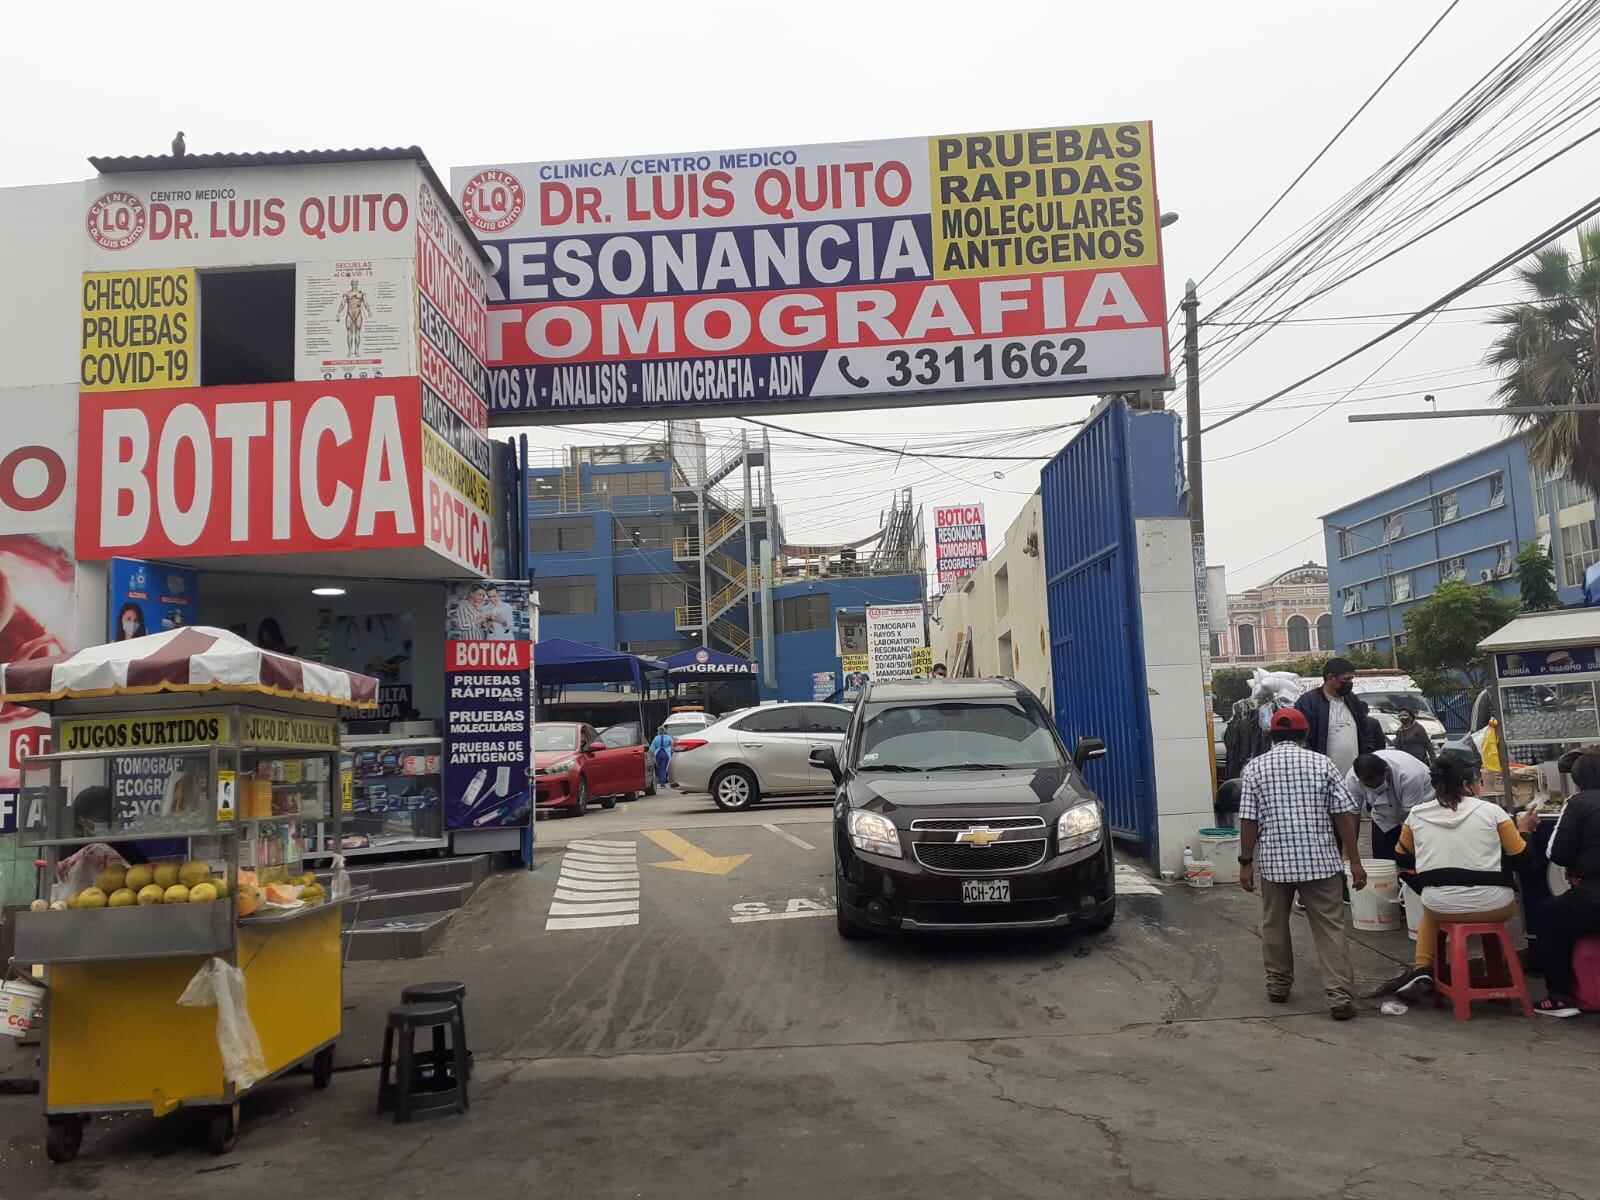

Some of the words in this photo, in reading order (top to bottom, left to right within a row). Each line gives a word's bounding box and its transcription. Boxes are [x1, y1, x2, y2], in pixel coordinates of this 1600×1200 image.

[719, 150, 798, 170] MEDICO
[938, 124, 1142, 172] PRUEBAS
[150, 190, 192, 203] CENTRO
[195, 188, 236, 201] MEDICO
[465, 170, 520, 196] CLINICA
[539, 181, 612, 227] DR.
[625, 170, 736, 222] LUIS
[754, 160, 912, 221] QUITO
[940, 162, 1143, 204] RAPIDAS
[91, 192, 144, 216] CLINICA
[478, 186, 507, 213] LQ
[102, 206, 130, 232] LQ
[149, 202, 200, 241] DR.
[209, 197, 286, 240] LUIS
[299, 193, 409, 240] QUITO
[497, 206, 522, 230] QUITO
[942, 195, 1145, 240] MOLECULARES
[483, 219, 932, 301] RESONANCIA
[942, 228, 1146, 272] ANTIGENOS
[335, 261, 373, 270] SECUELAS
[82, 274, 188, 313] CHEQUEOS
[418, 225, 488, 364] TOMOGRAFIA
[487, 271, 1149, 361] TOMOGRAFIA
[81, 312, 188, 350] PRUEBAS
[420, 294, 486, 400] RESONANCIA
[80, 349, 189, 387] COVID-19
[885, 337, 1089, 387] 3311662
[421, 340, 481, 431] ECOGRAFIA
[487, 367, 522, 410] YOS
[525, 367, 538, 407] X
[551, 363, 628, 408] ANALISIS
[641, 357, 755, 403] MAMOGRAFIA
[768, 354, 804, 397] ADN
[422, 384, 447, 438] RAYOS
[99, 394, 418, 549] BOTICA
[429, 478, 491, 577] BOTICA
[937, 507, 981, 526] BOTICA
[938, 525, 983, 543] RESONANCIA
[939, 541, 984, 558] TOMOGRAFIA
[940, 557, 976, 571] ECOGRAFIA
[873, 622, 917, 631] TOMOGRAFIA
[455, 642, 520, 667] BOTICA
[874, 637, 920, 646] LABORATORIO
[875, 653, 912, 662] ECOGRAFIA
[451, 686, 523, 698] RÁPIDAS
[454, 675, 521, 686] PRUEBAS
[449, 710, 525, 723] PRUEBAS
[450, 722, 524, 734] MOLECULARES
[68, 723, 127, 750] JUGOS
[130, 717, 219, 747] SURTIDOS
[249, 718, 276, 740] JUGO
[278, 719, 290, 742] DE
[290, 722, 330, 745] NARANJA
[450, 751, 525, 765] ANTIGENOS
[451, 741, 505, 753] PRUEBAS
[507, 740, 524, 751] DE
[964, 886, 1009, 901] ACH-217
